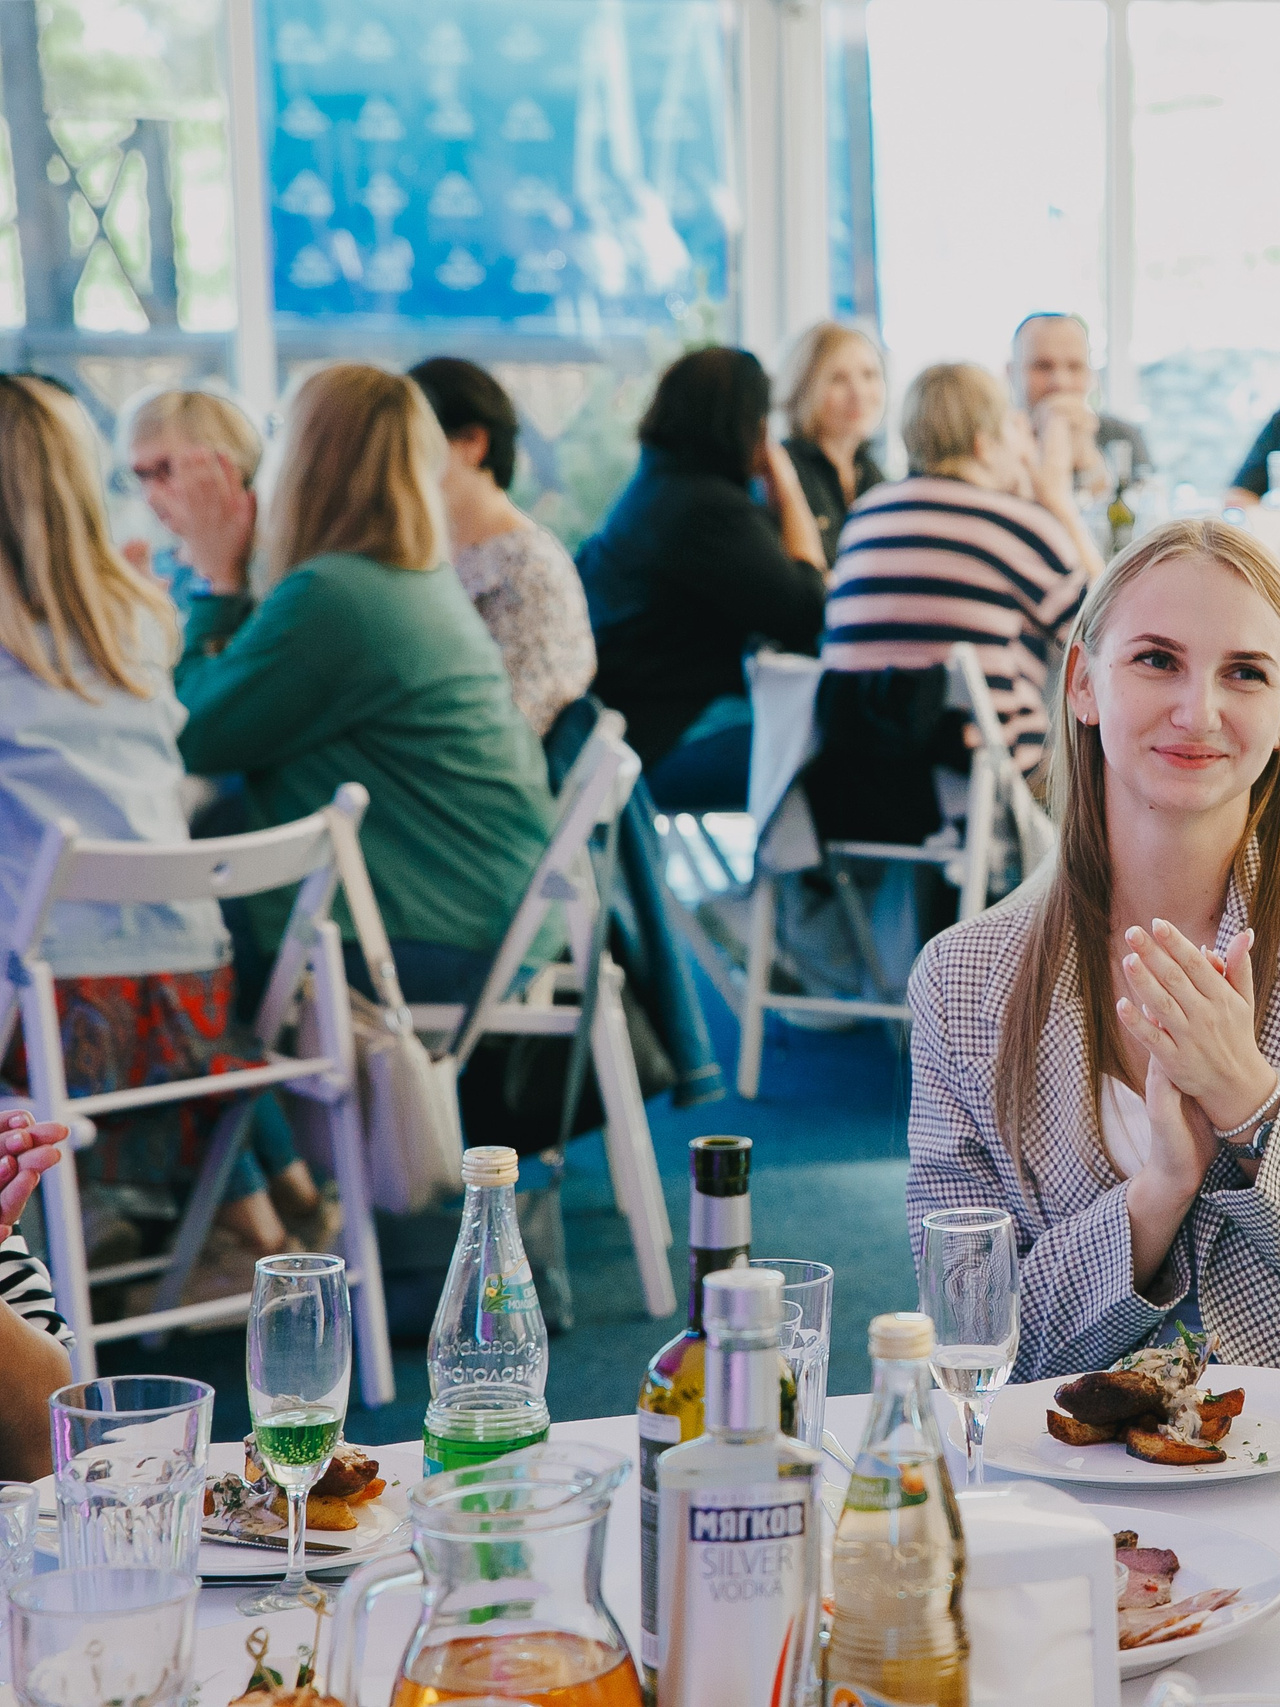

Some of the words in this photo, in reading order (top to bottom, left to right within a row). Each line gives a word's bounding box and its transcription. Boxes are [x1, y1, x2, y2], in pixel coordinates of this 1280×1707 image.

[694, 1504, 803, 1539] МЯГКОВ
[702, 1543, 794, 1579] SILVER
[708, 1579, 784, 1603] VODKA
